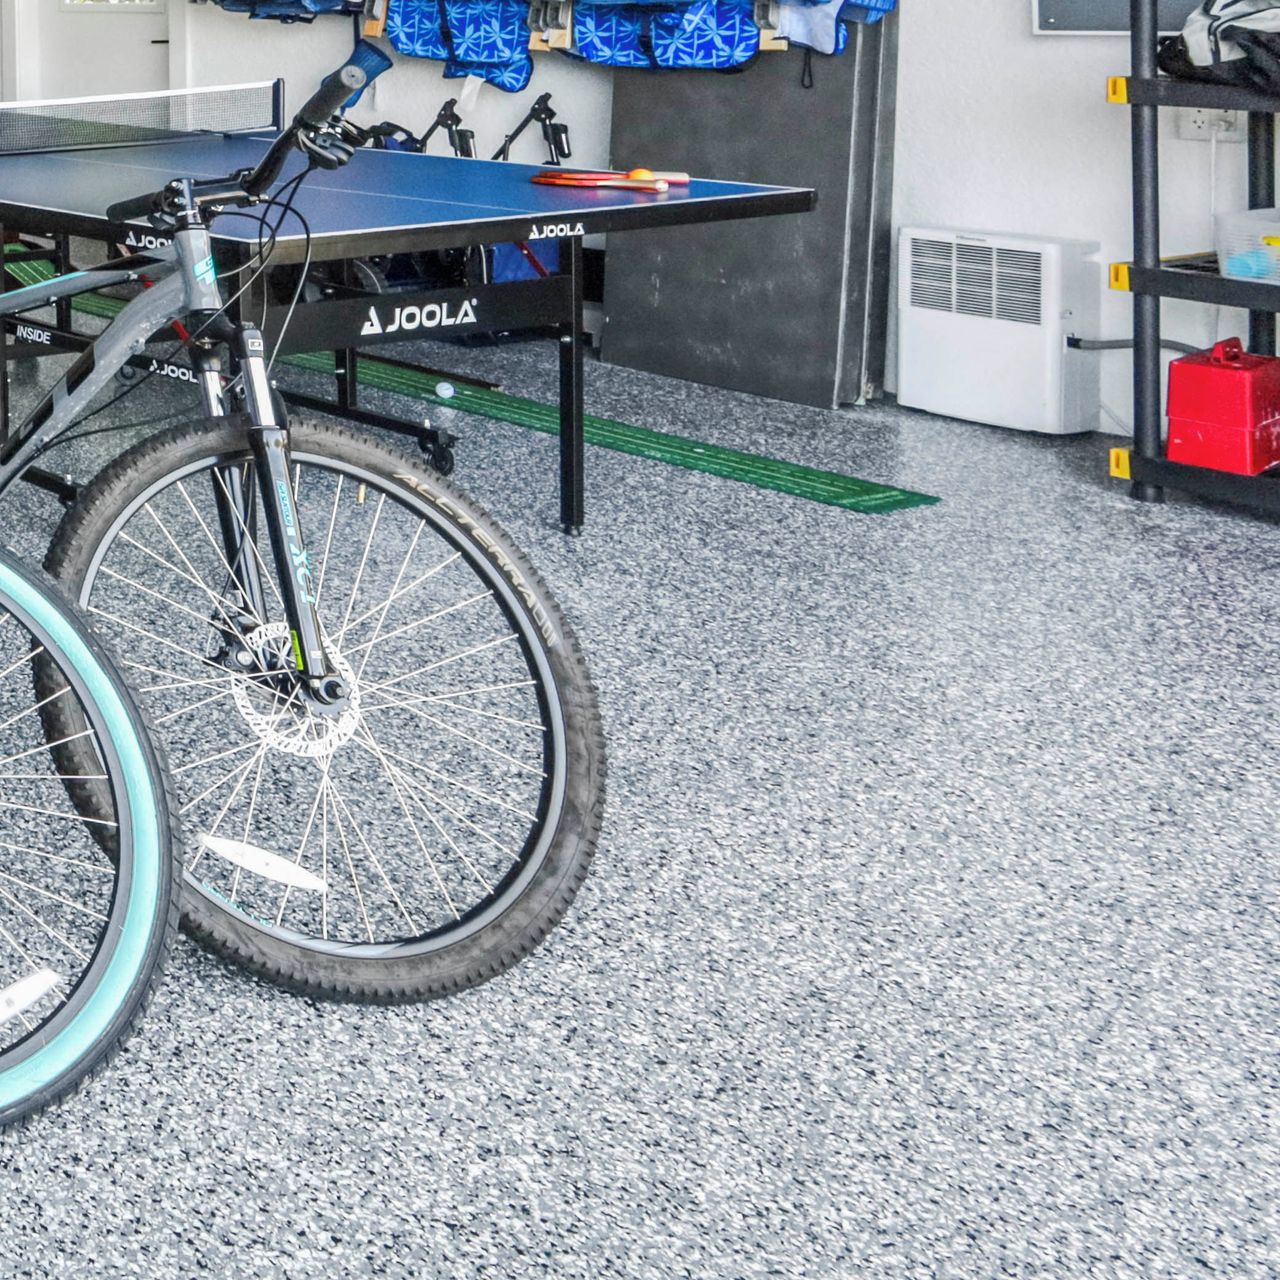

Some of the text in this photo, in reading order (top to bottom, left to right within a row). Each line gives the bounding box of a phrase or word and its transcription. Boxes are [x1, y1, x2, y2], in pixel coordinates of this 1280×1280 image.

[540, 223, 584, 238] JOOLA
[137, 235, 174, 248] JOO
[385, 300, 477, 333] JOOLA
[16, 324, 52, 345] INSIDE
[160, 365, 200, 384] JOOL
[392, 473, 454, 516] ALL
